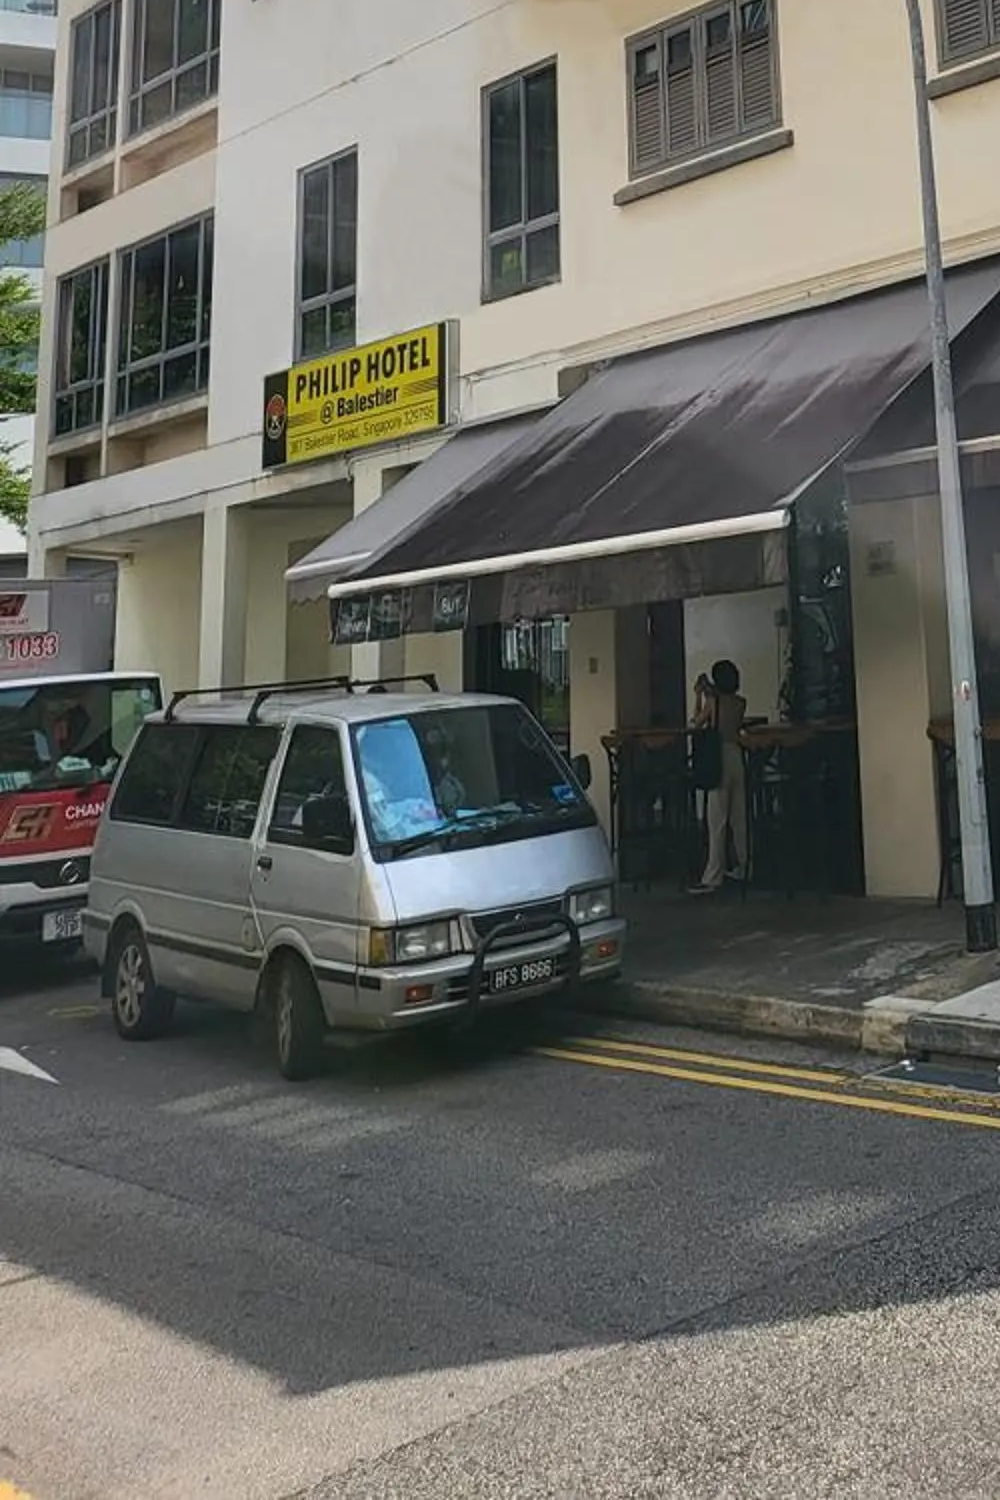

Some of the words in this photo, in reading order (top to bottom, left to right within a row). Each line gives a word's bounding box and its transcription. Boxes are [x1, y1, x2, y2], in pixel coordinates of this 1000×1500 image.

[295, 358, 360, 404] PHILIP
[367, 337, 430, 383] HOTEL
[320, 401, 334, 424] @
[337, 386, 399, 417] Balestier
